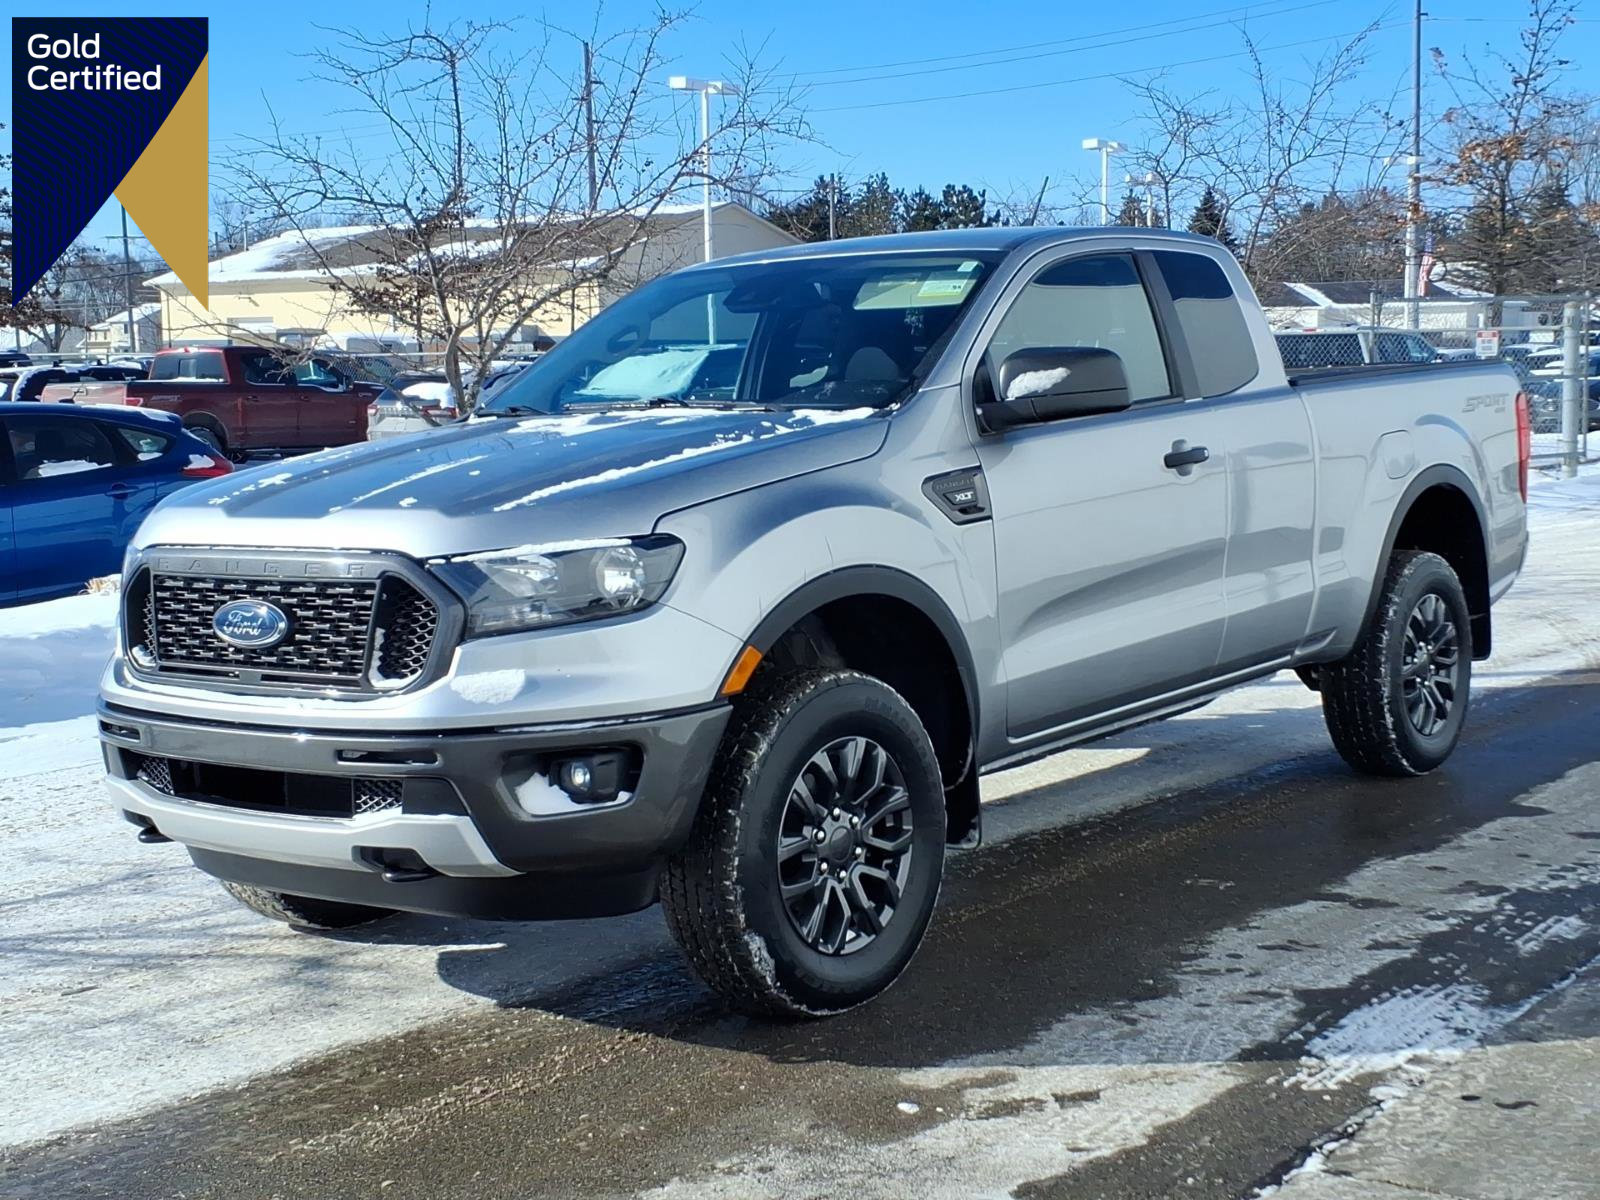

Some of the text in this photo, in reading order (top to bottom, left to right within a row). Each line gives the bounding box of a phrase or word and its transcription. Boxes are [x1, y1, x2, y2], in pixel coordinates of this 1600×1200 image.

[1462, 393, 1509, 413] SPORT
[955, 491, 973, 502] XLT
[157, 557, 365, 577] RANGER
[223, 610, 263, 636] Ford
